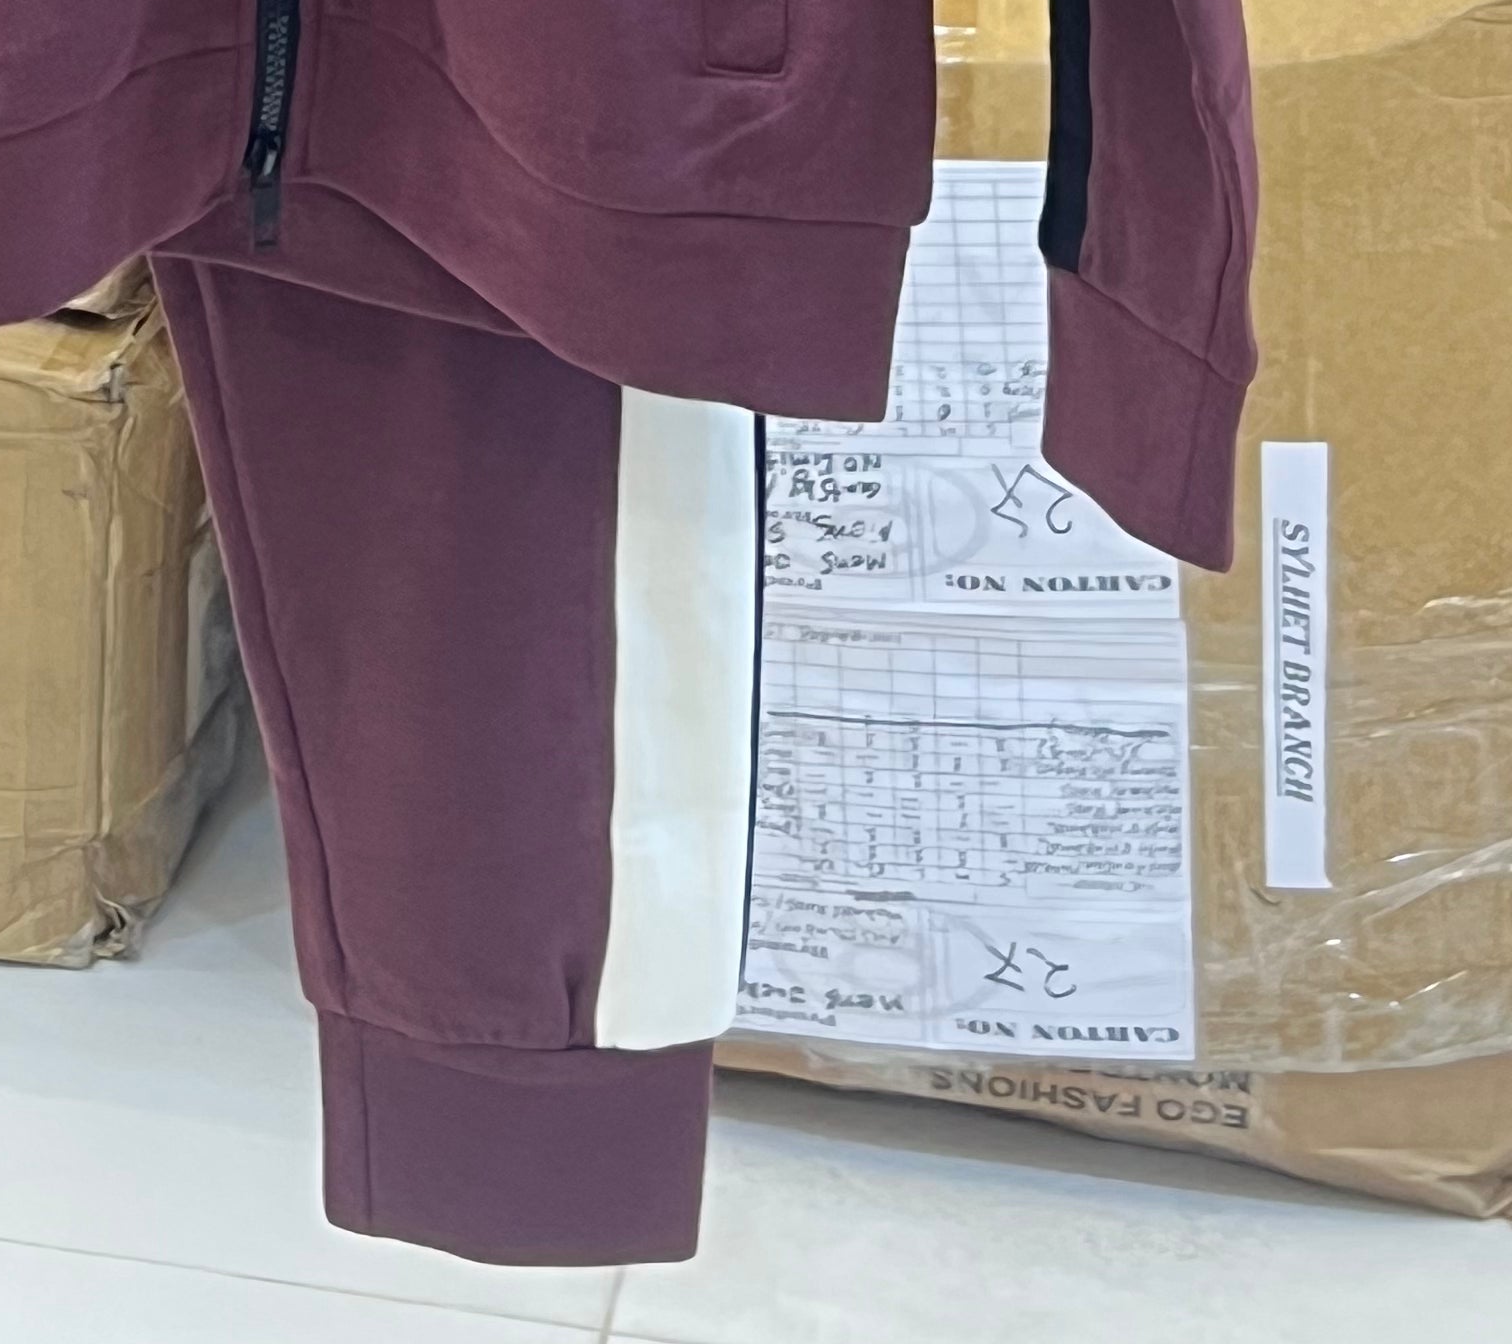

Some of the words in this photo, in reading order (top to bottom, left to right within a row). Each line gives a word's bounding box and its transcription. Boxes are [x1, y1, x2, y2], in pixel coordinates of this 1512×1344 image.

[944, 574, 1008, 591] NO:
[1021, 574, 1172, 592] CARTON
[1279, 519, 1316, 655] SYLHET
[1281, 660, 1315, 803] BRANCH
[983, 944, 1076, 999] 27
[1032, 1024, 1180, 1044] CARTON
[930, 1069, 1142, 1118] FASHIONS
[1156, 1099, 1250, 1130] EGO
